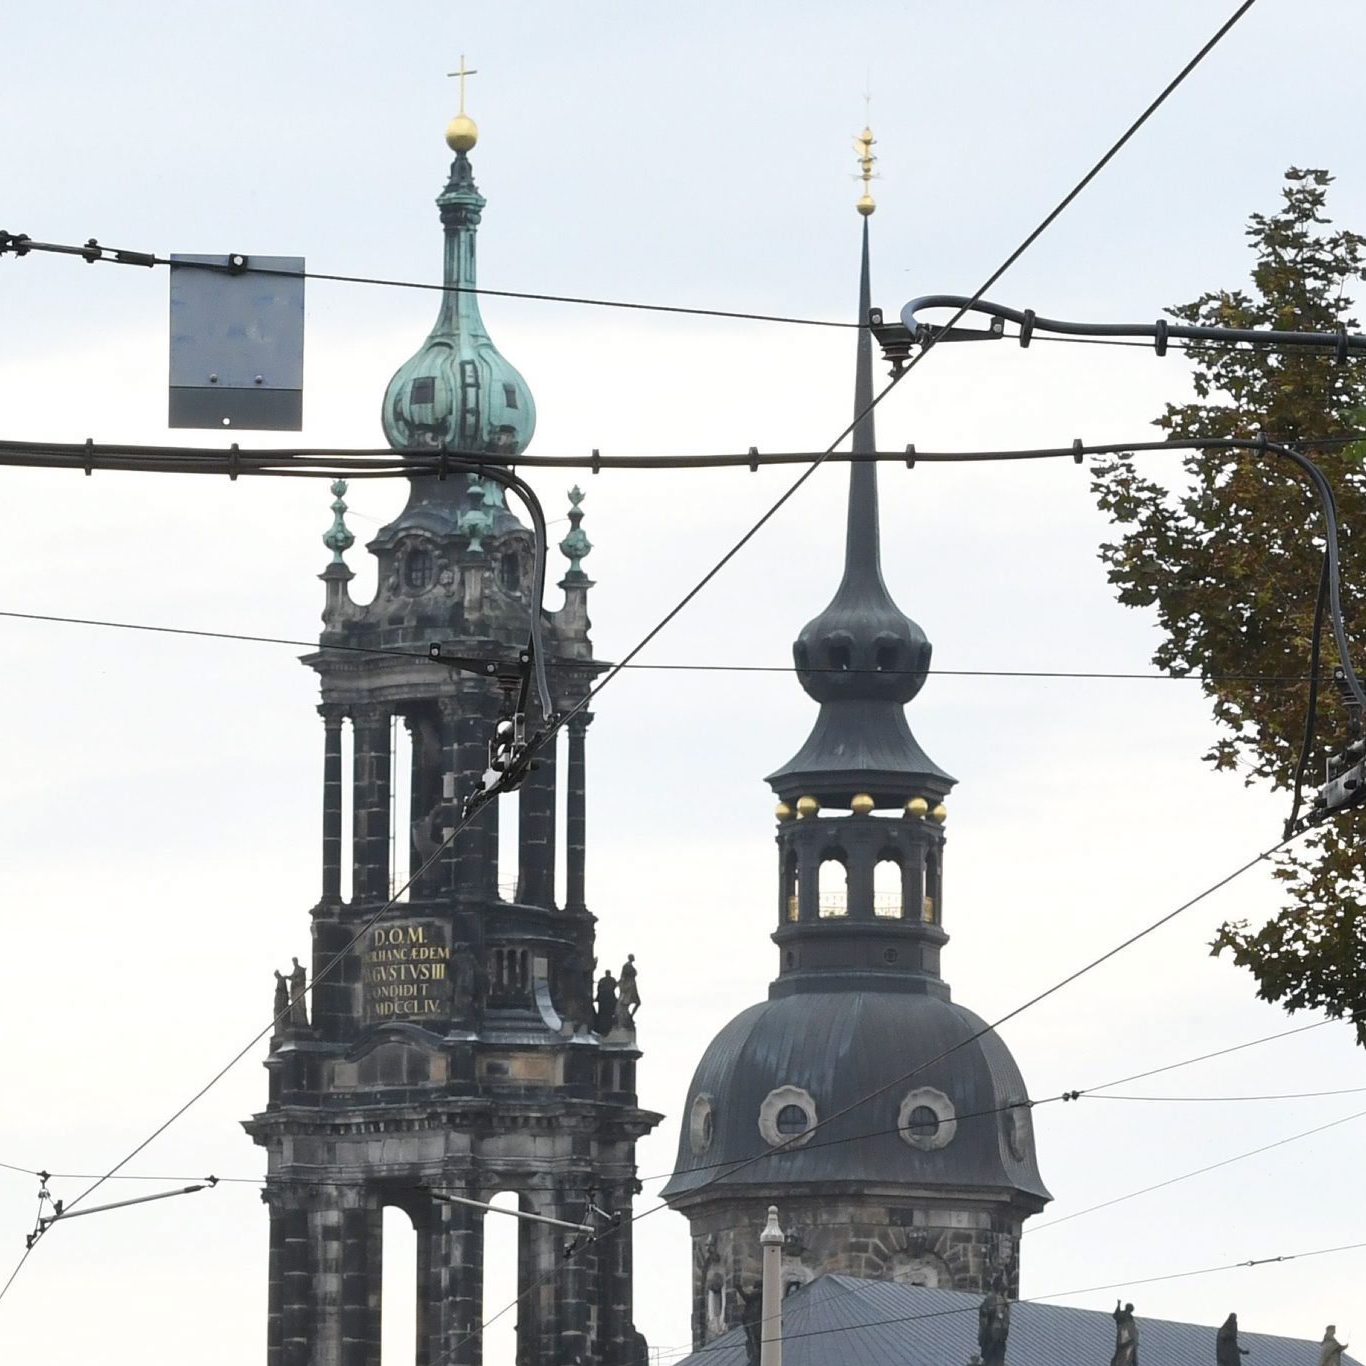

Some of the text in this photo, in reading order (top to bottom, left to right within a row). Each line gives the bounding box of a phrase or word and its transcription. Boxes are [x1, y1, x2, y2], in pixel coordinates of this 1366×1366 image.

[375, 926, 428, 946] D.O.M.
[364, 963, 430, 982] GVSTVS
[368, 983, 429, 998] ONDIDIT
